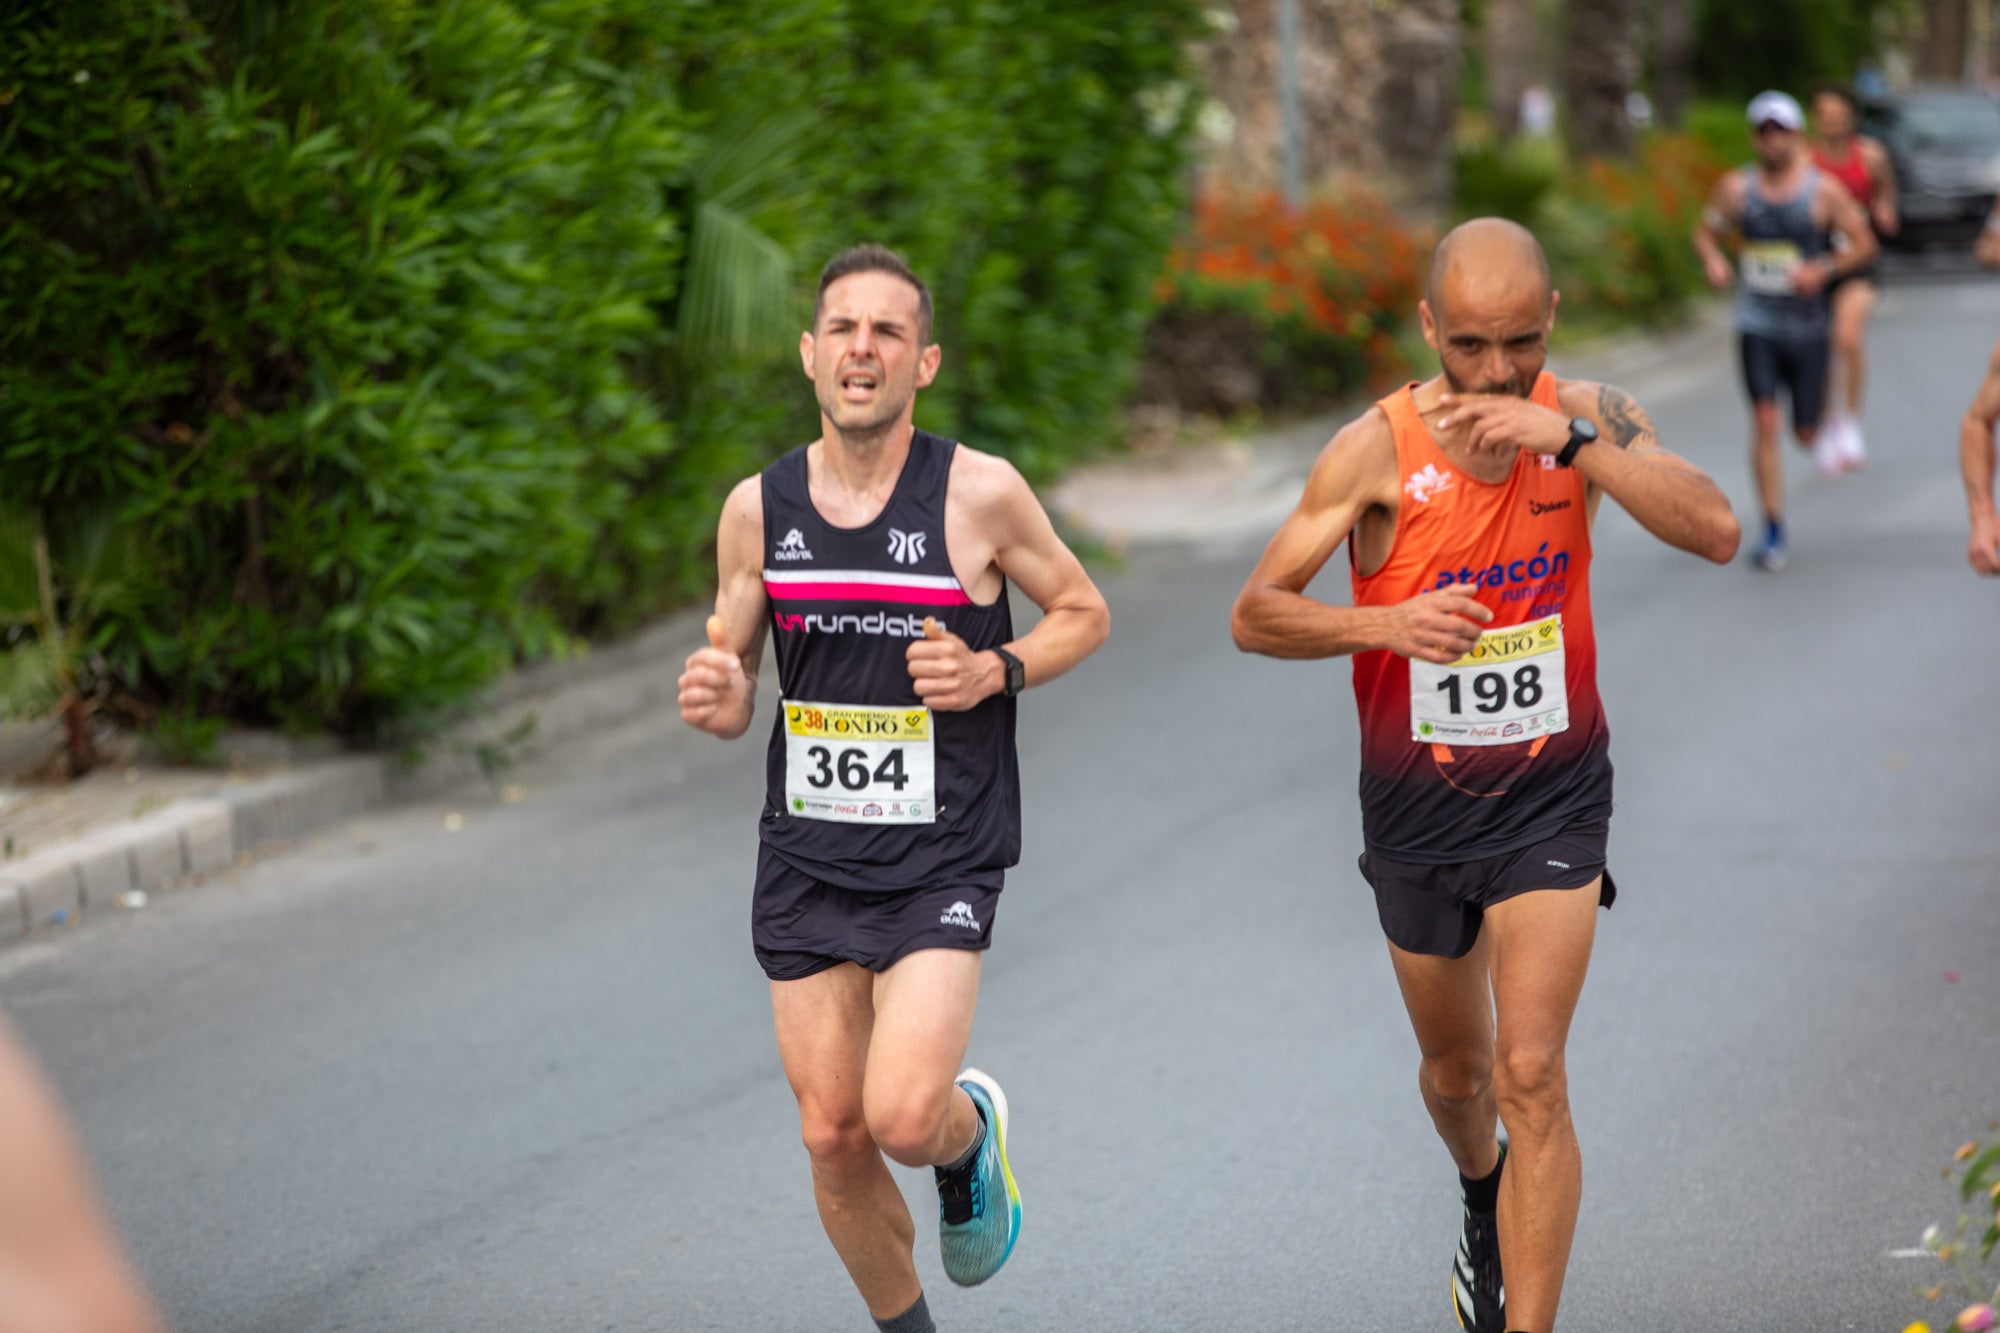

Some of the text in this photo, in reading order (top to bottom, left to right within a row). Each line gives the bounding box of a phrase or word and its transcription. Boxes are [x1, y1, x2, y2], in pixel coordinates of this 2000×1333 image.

[1502, 578, 1566, 603] running
[1470, 636, 1533, 659] ONDO
[1437, 664, 1543, 715] 198
[804, 709, 823, 730] 38
[823, 718, 898, 735] FONDO
[854, 711, 890, 720] PREMIO
[806, 745, 909, 792] 364
